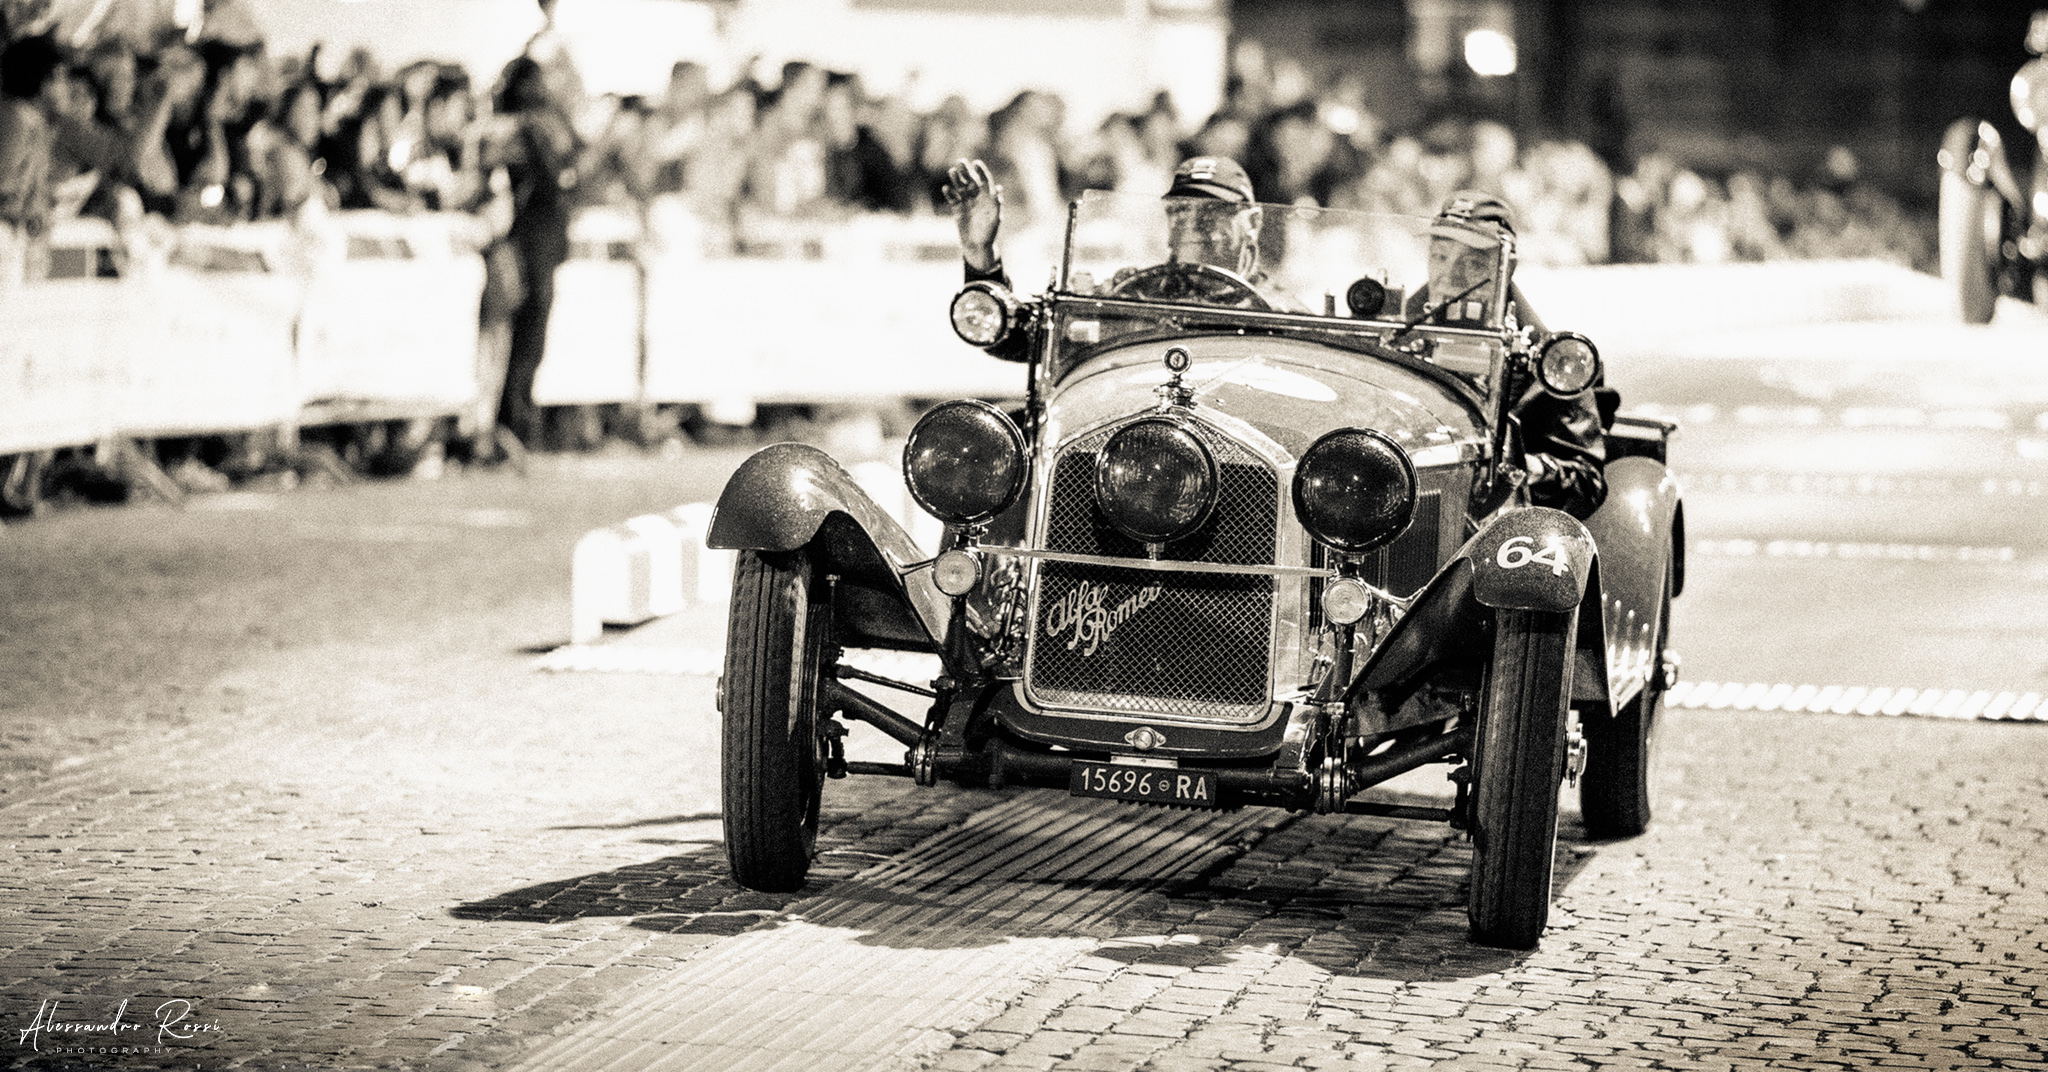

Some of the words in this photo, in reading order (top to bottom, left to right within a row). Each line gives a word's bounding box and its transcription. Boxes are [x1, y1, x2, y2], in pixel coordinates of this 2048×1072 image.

[1497, 533, 1569, 576] 64
[1047, 580, 1109, 650] Alfa
[1082, 767, 1152, 795] 15696
[1176, 775, 1208, 800] RA
